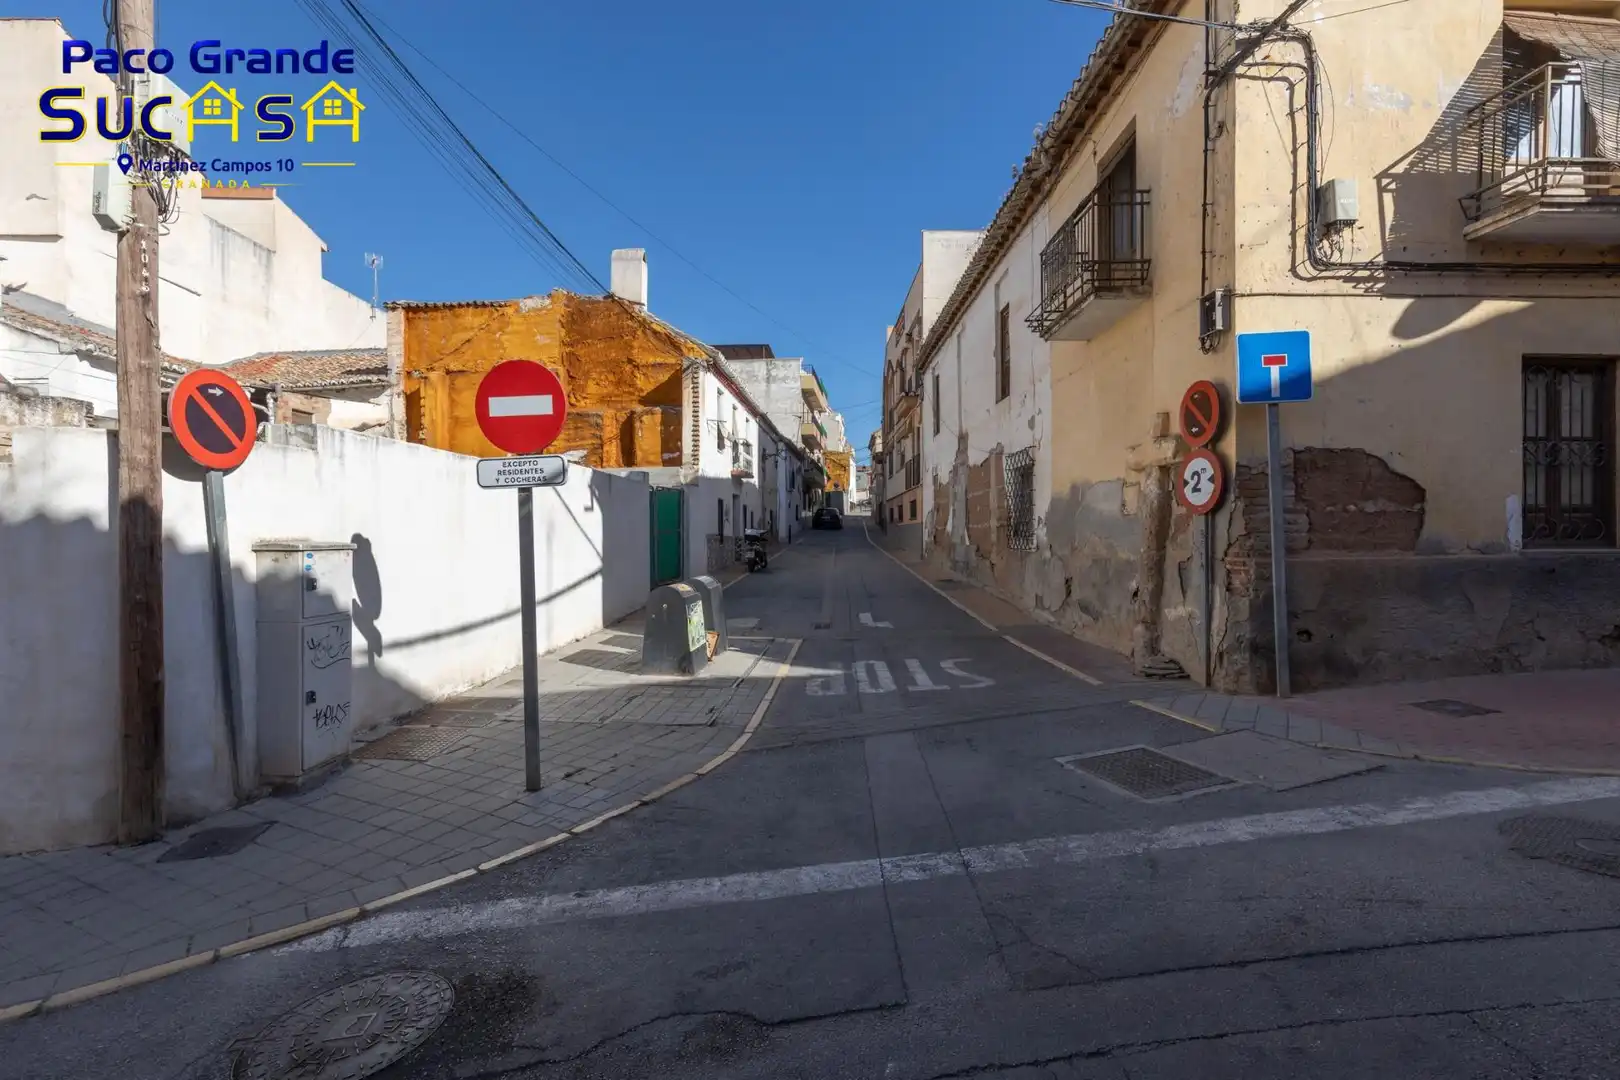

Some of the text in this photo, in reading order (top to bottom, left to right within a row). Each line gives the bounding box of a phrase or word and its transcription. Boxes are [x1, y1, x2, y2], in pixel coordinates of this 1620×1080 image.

[502, 460, 539, 468] EXCEPTO
[497, 468, 545, 476] RESIDENTES
[504, 476, 548, 484] COCHERAS
[804, 657, 997, 697] STOP
